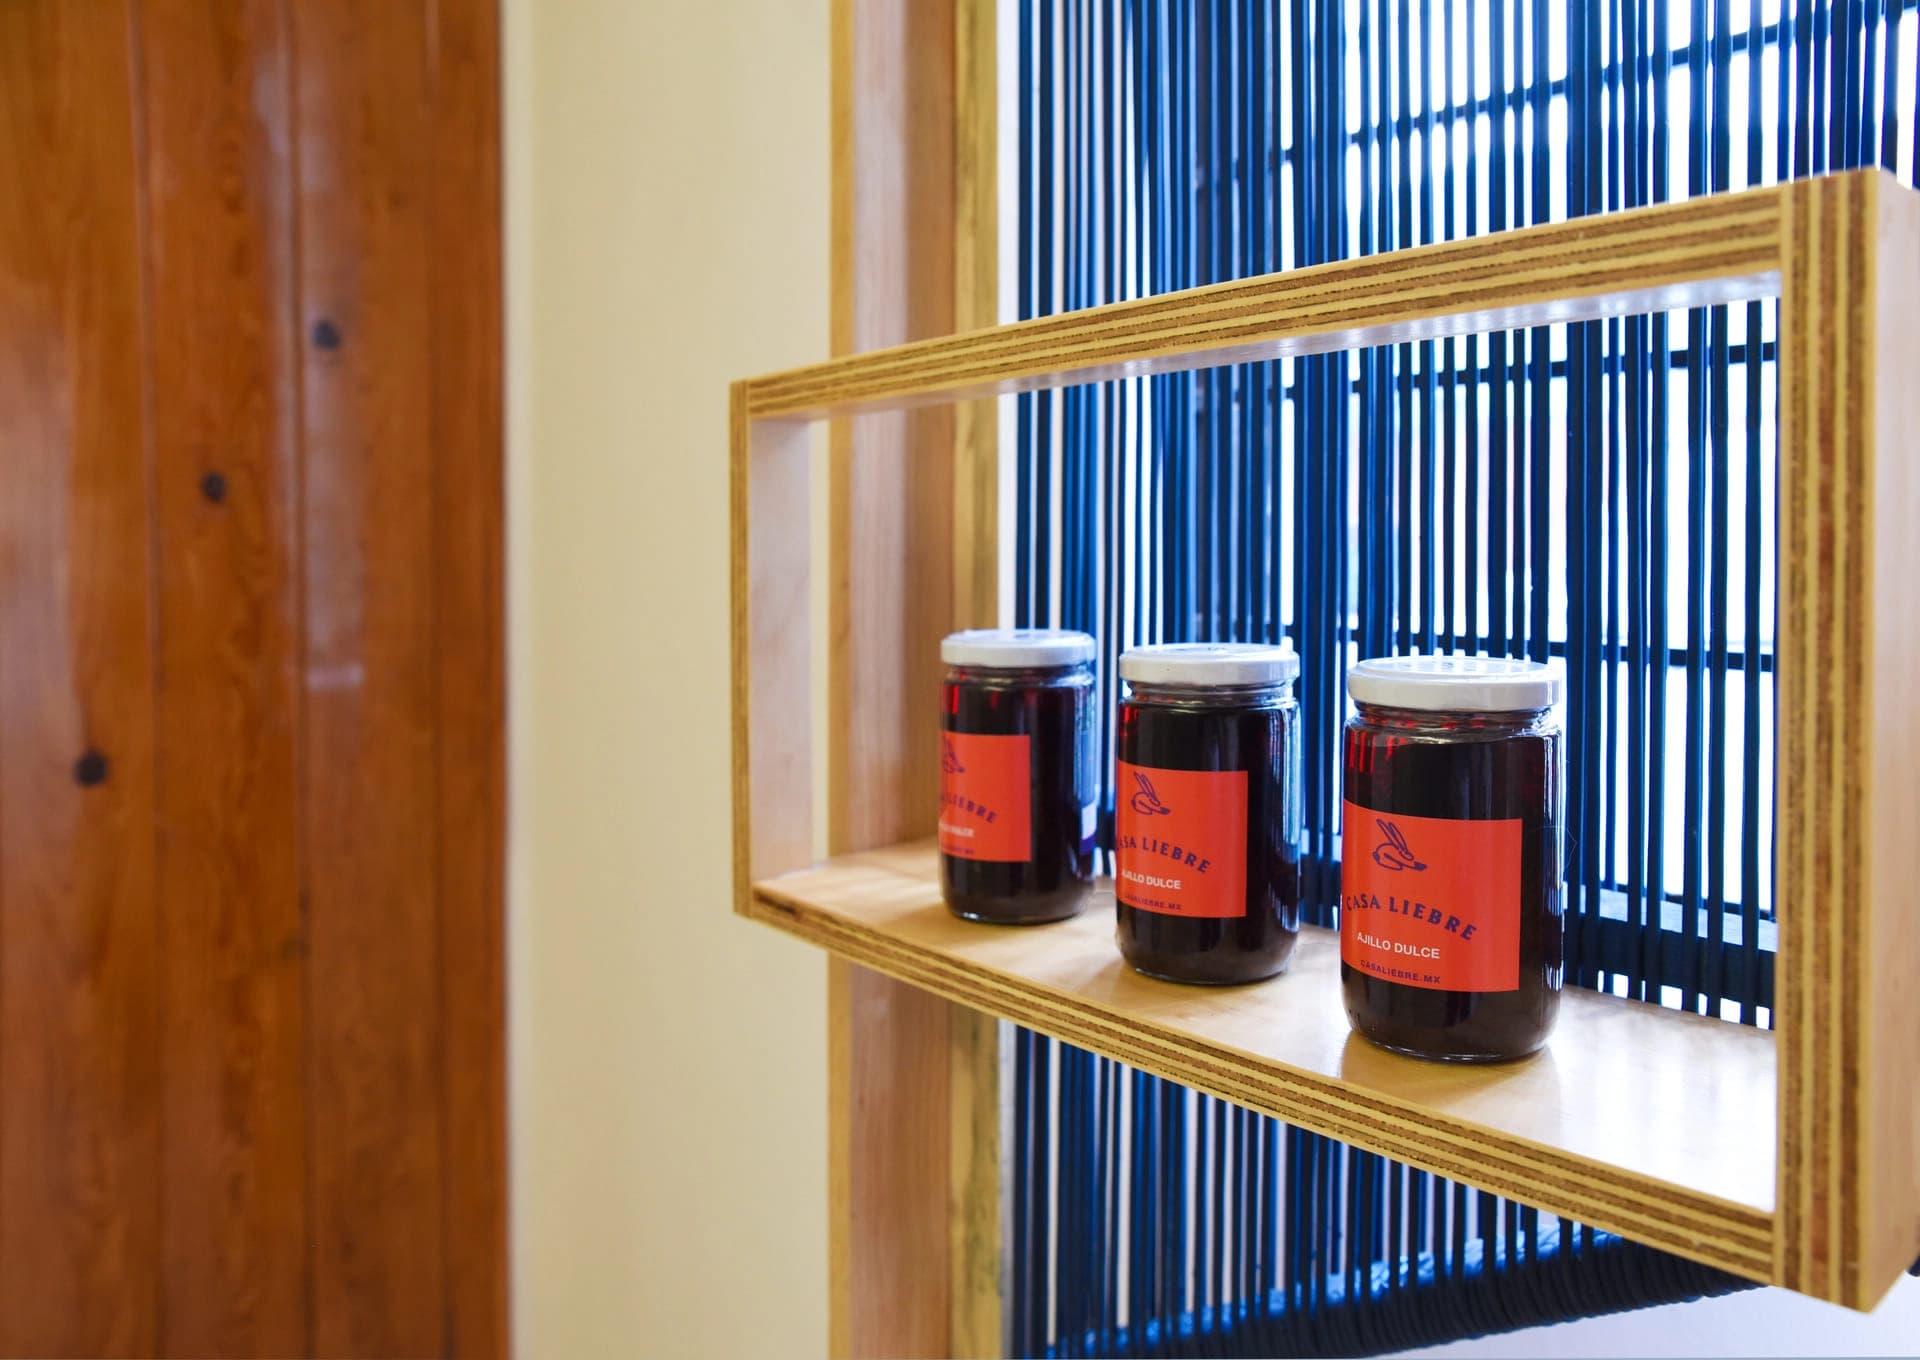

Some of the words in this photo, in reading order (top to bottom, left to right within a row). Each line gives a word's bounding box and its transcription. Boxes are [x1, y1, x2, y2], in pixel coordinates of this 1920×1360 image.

[1142, 836, 1211, 874] LIEBRE
[1146, 875, 1182, 890] DULCE
[1346, 893, 1381, 912] CASA
[1388, 896, 1477, 941] LIEBRE
[1357, 931, 1392, 951] AJILLO
[1394, 942, 1441, 960] DULCE
[1360, 959, 1441, 984] CASALIEBRE.MX
